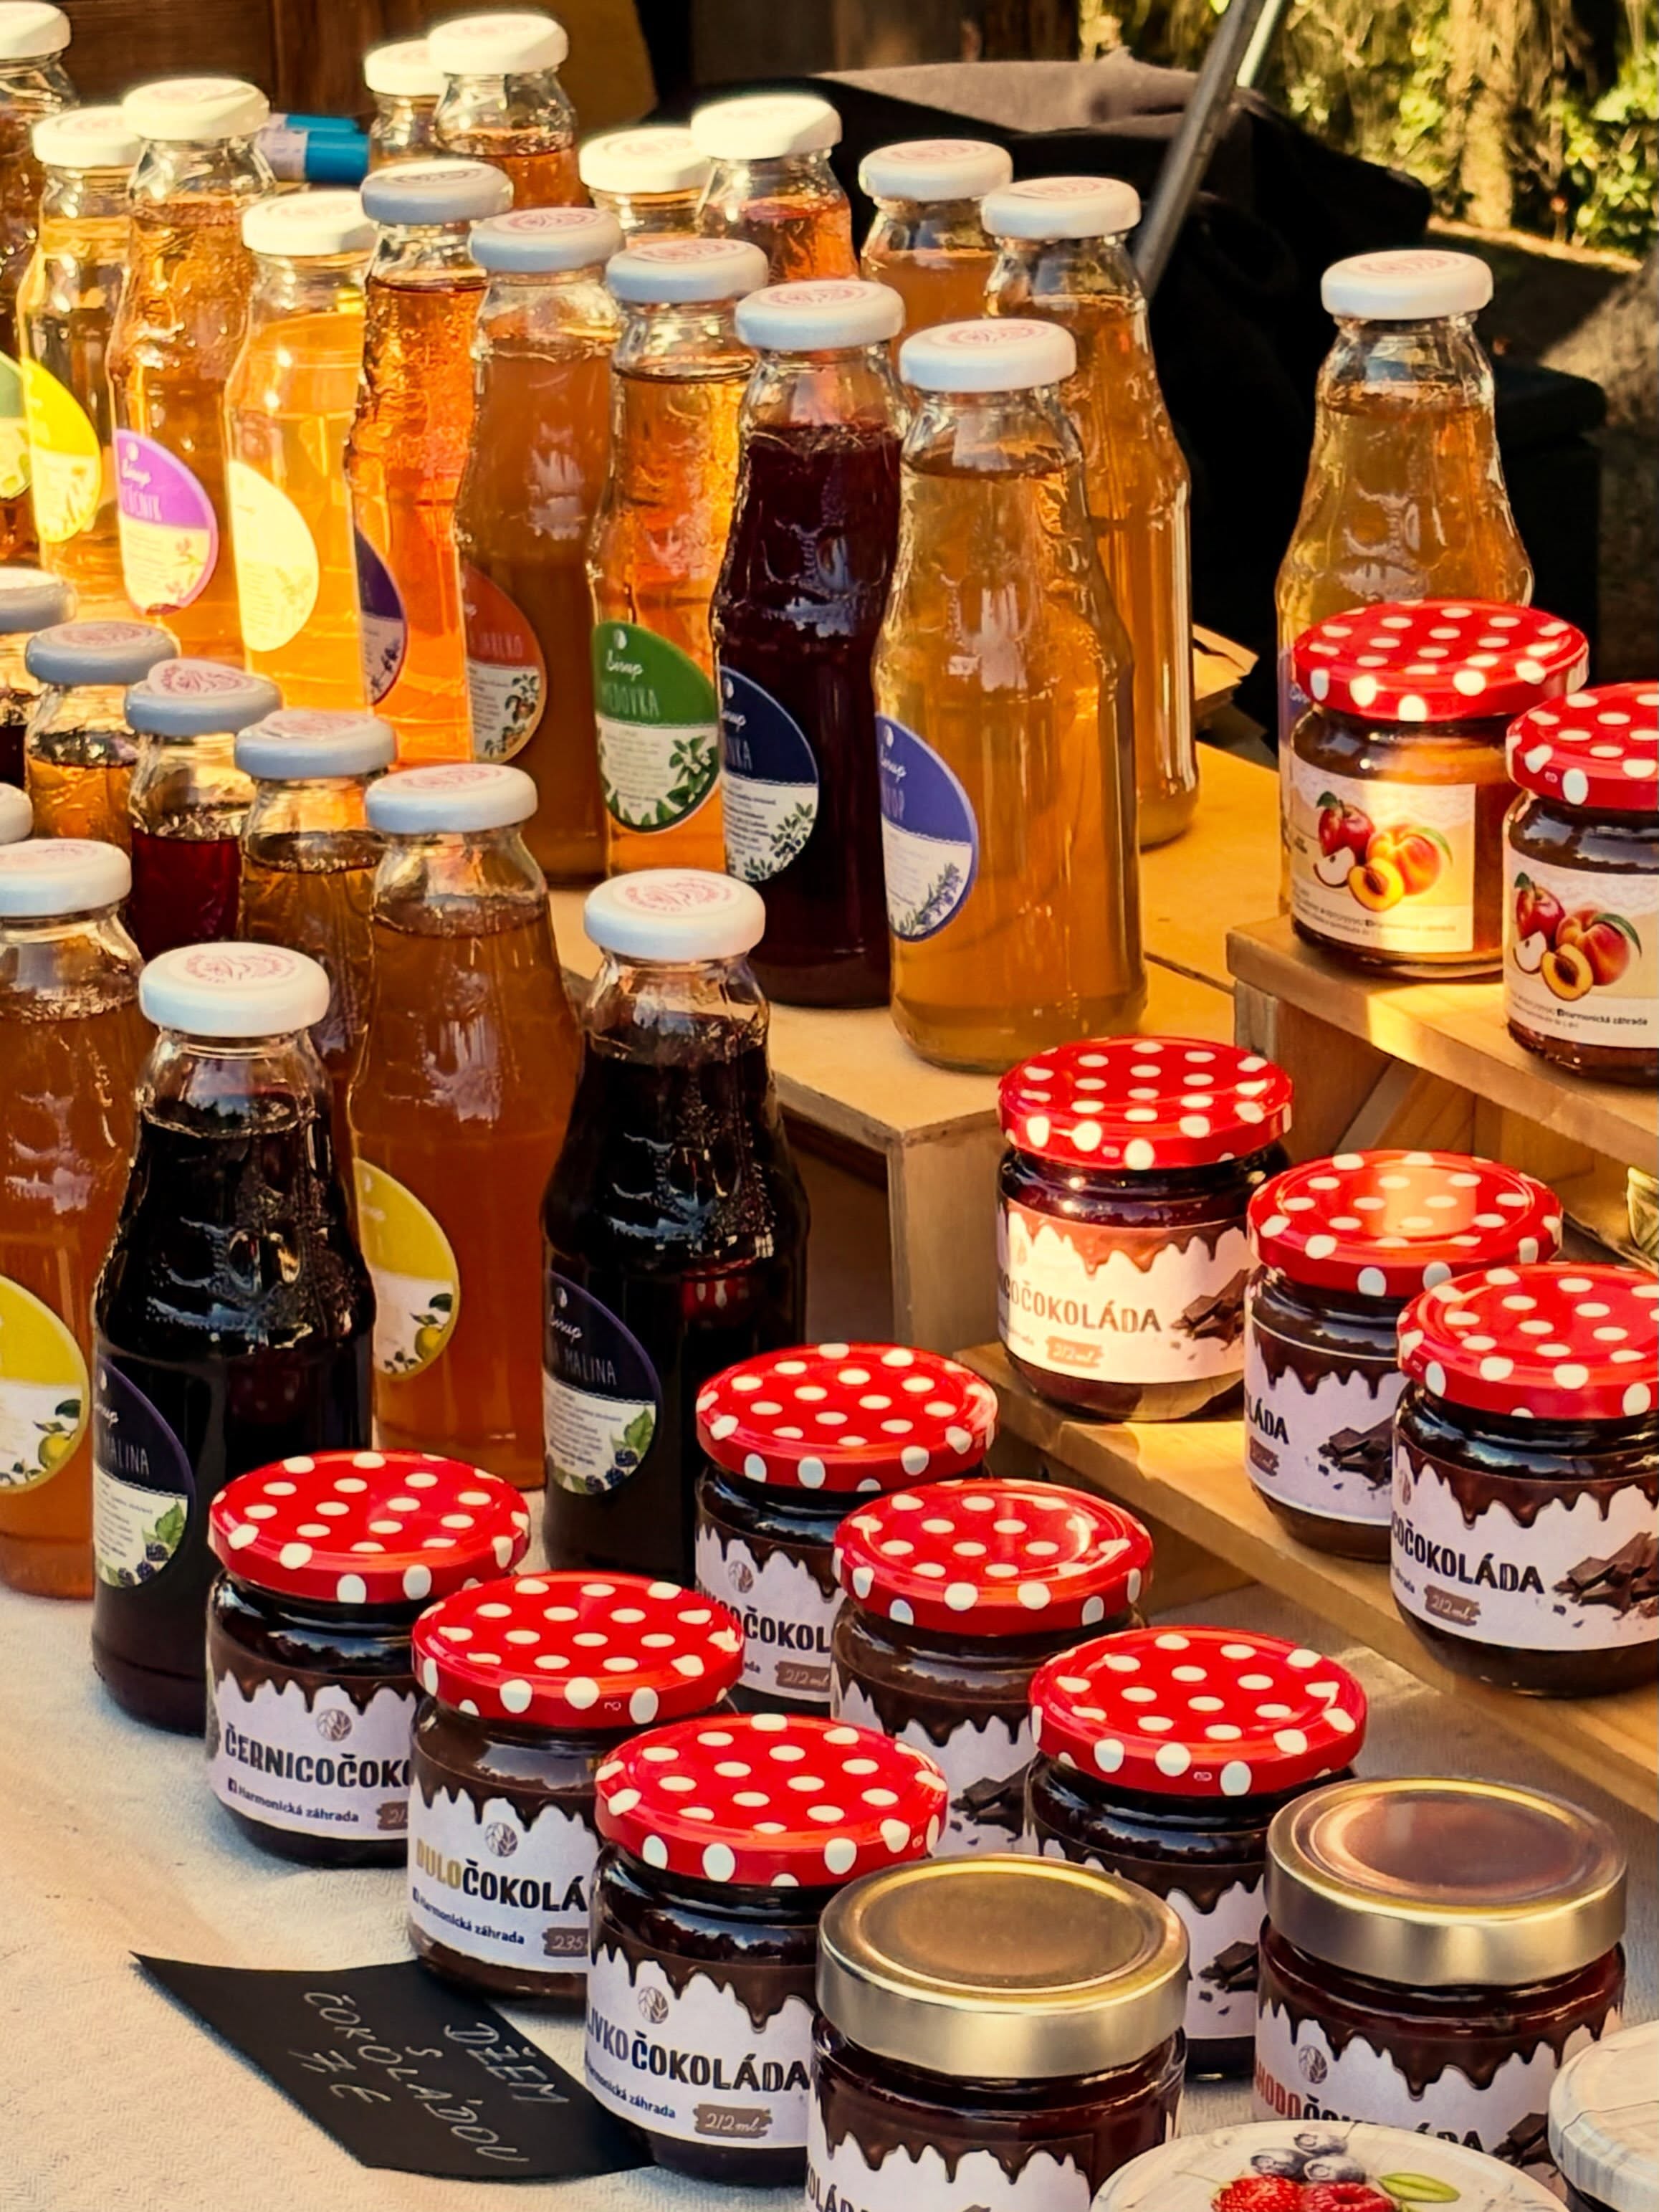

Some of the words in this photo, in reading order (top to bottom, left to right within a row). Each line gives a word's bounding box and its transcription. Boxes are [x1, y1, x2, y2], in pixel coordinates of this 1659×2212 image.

[305, 1806, 360, 1824] záhrada
[474, 1924, 525, 1945] záhrada
[444, 2022, 570, 2104] DŽEM
[303, 1991, 531, 2163] ČOKOLÁDOU
[628, 2093, 676, 2119] záhrada
